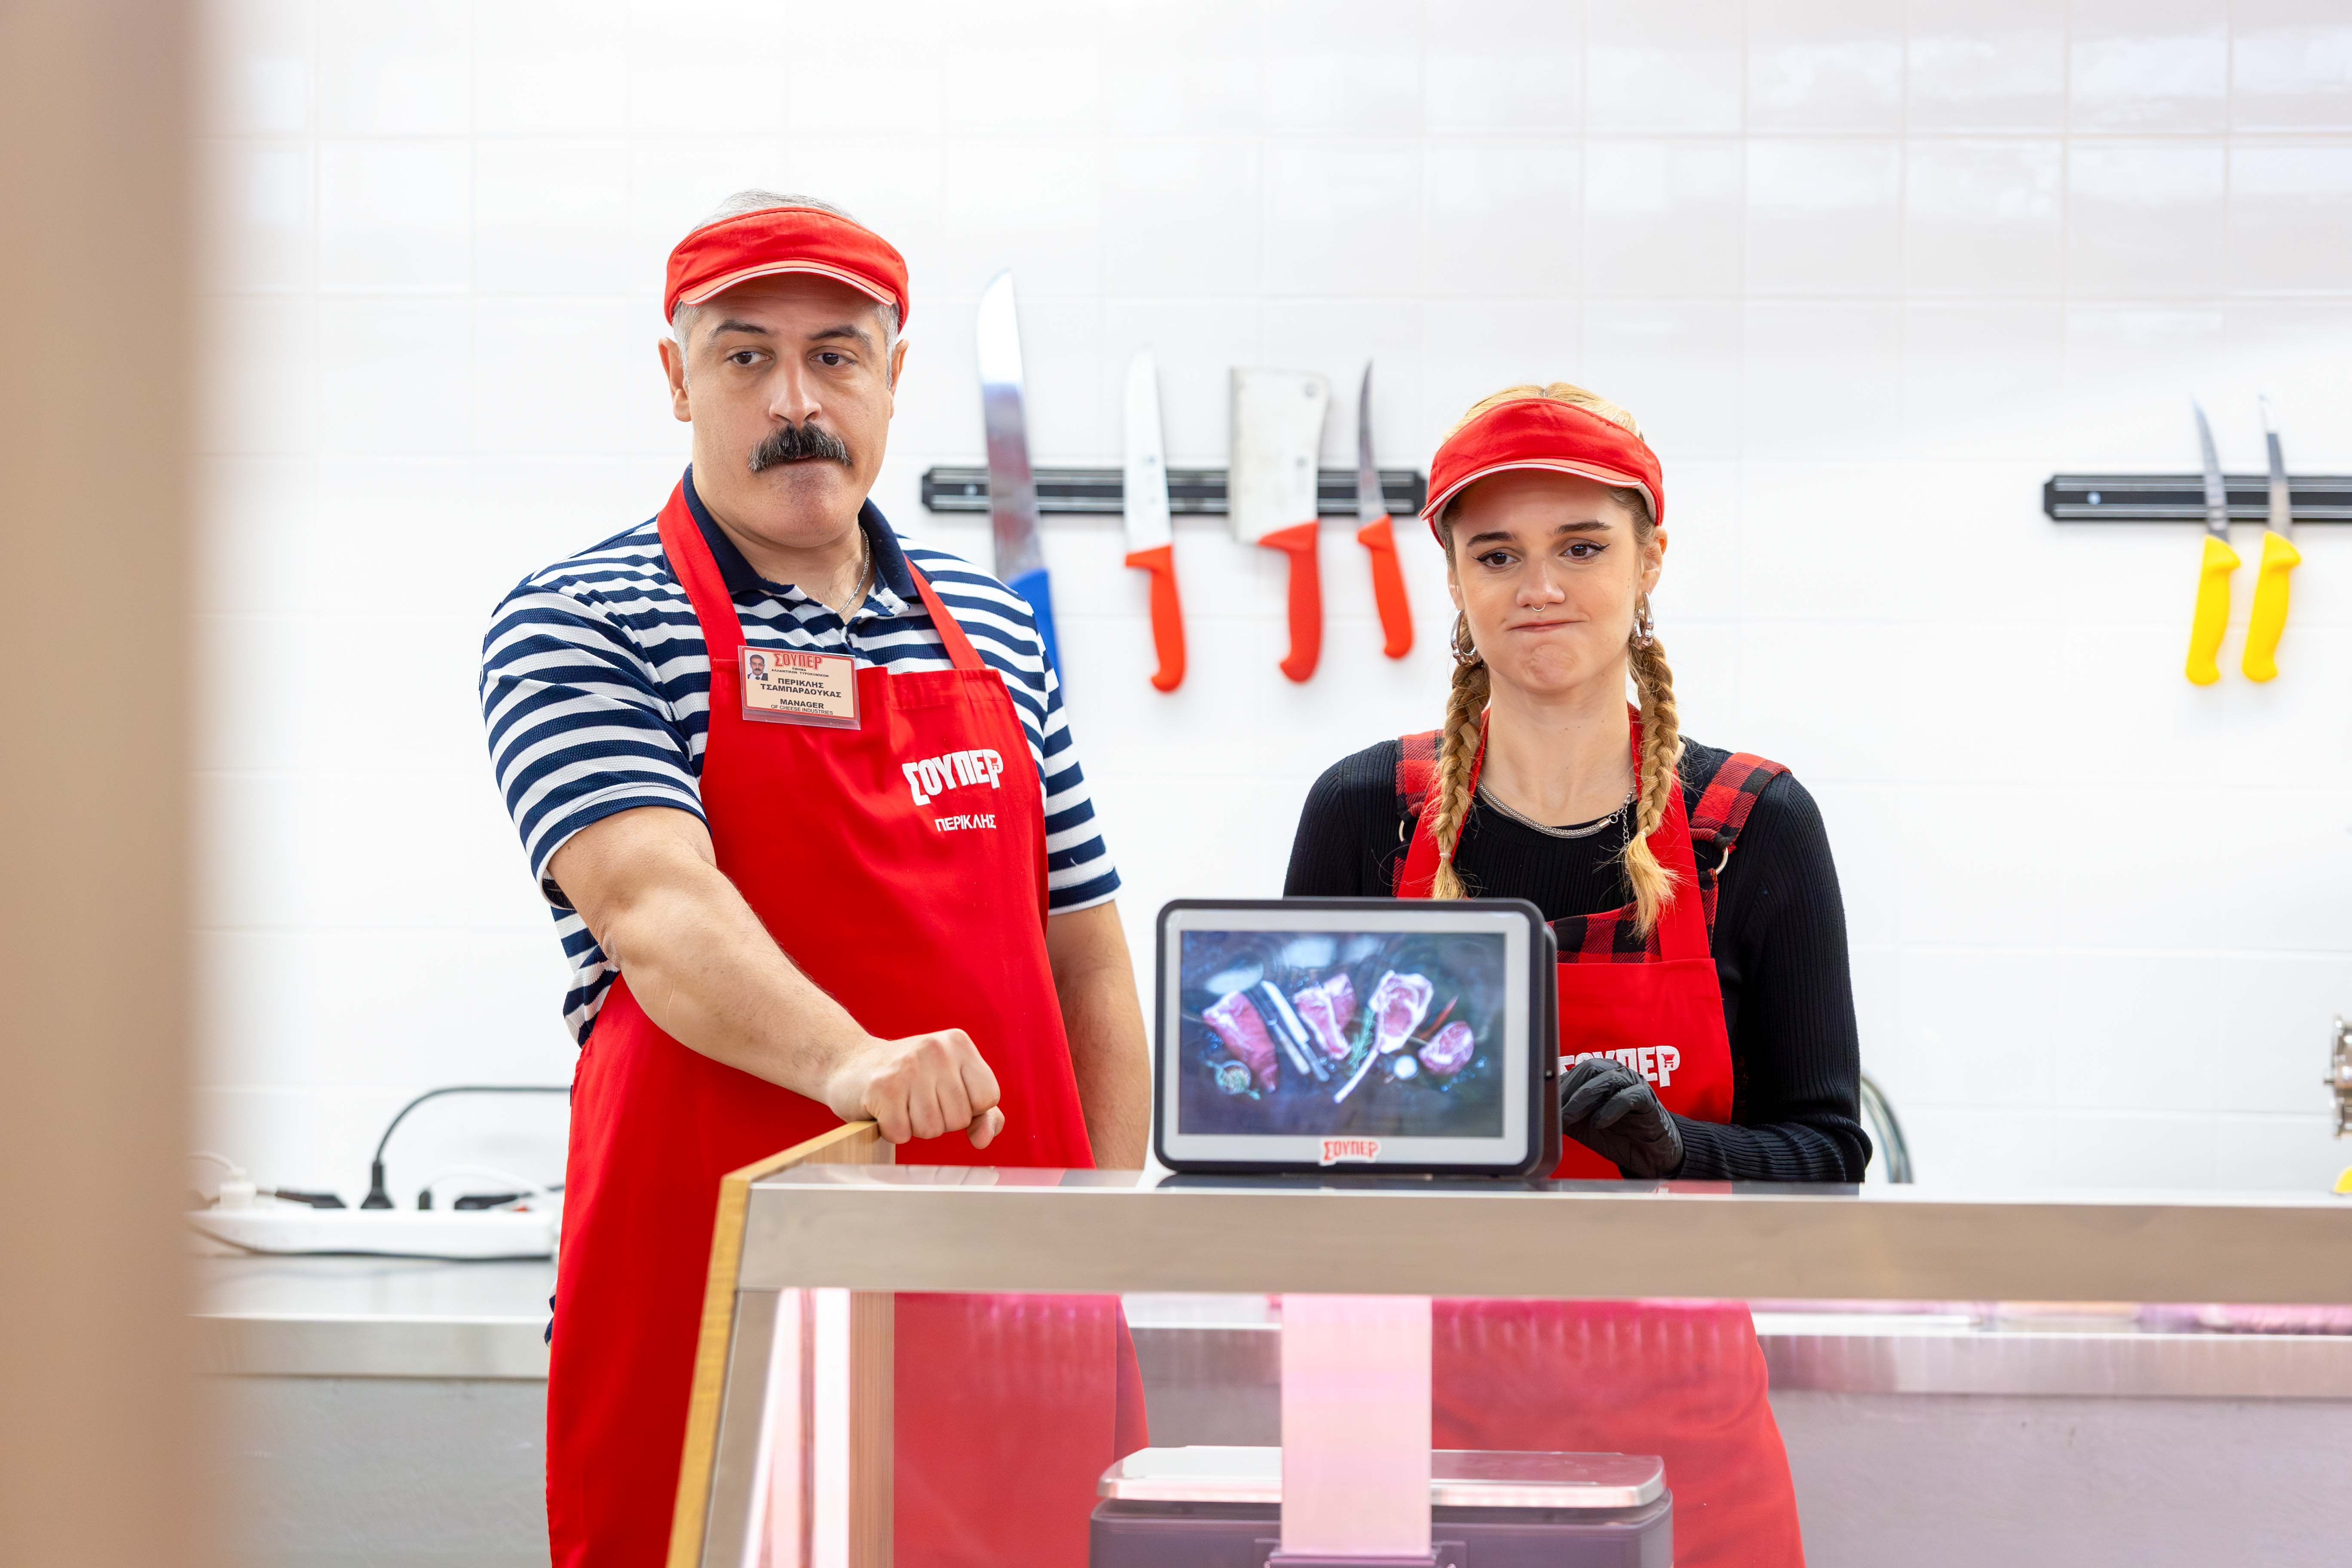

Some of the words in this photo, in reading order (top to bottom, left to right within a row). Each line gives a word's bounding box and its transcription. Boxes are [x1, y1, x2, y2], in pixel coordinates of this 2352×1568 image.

[774, 652, 822, 670] ΣΟΥΠΕΡ
[760, 683, 842, 698] ΤΣΑΜΠΑΡΔΟΥΚΑΣ
[778, 678, 824, 689] ΠΕΡΙΚΛΗΣ
[780, 698, 824, 709] MANAGER
[902, 749, 1004, 806] ΣΟΥΠΕΡ
[934, 814, 996, 832] ΠΕΡΙΚΛΗΣ
[1323, 1140, 1378, 1161] ΣΟΥΠΕΡ
